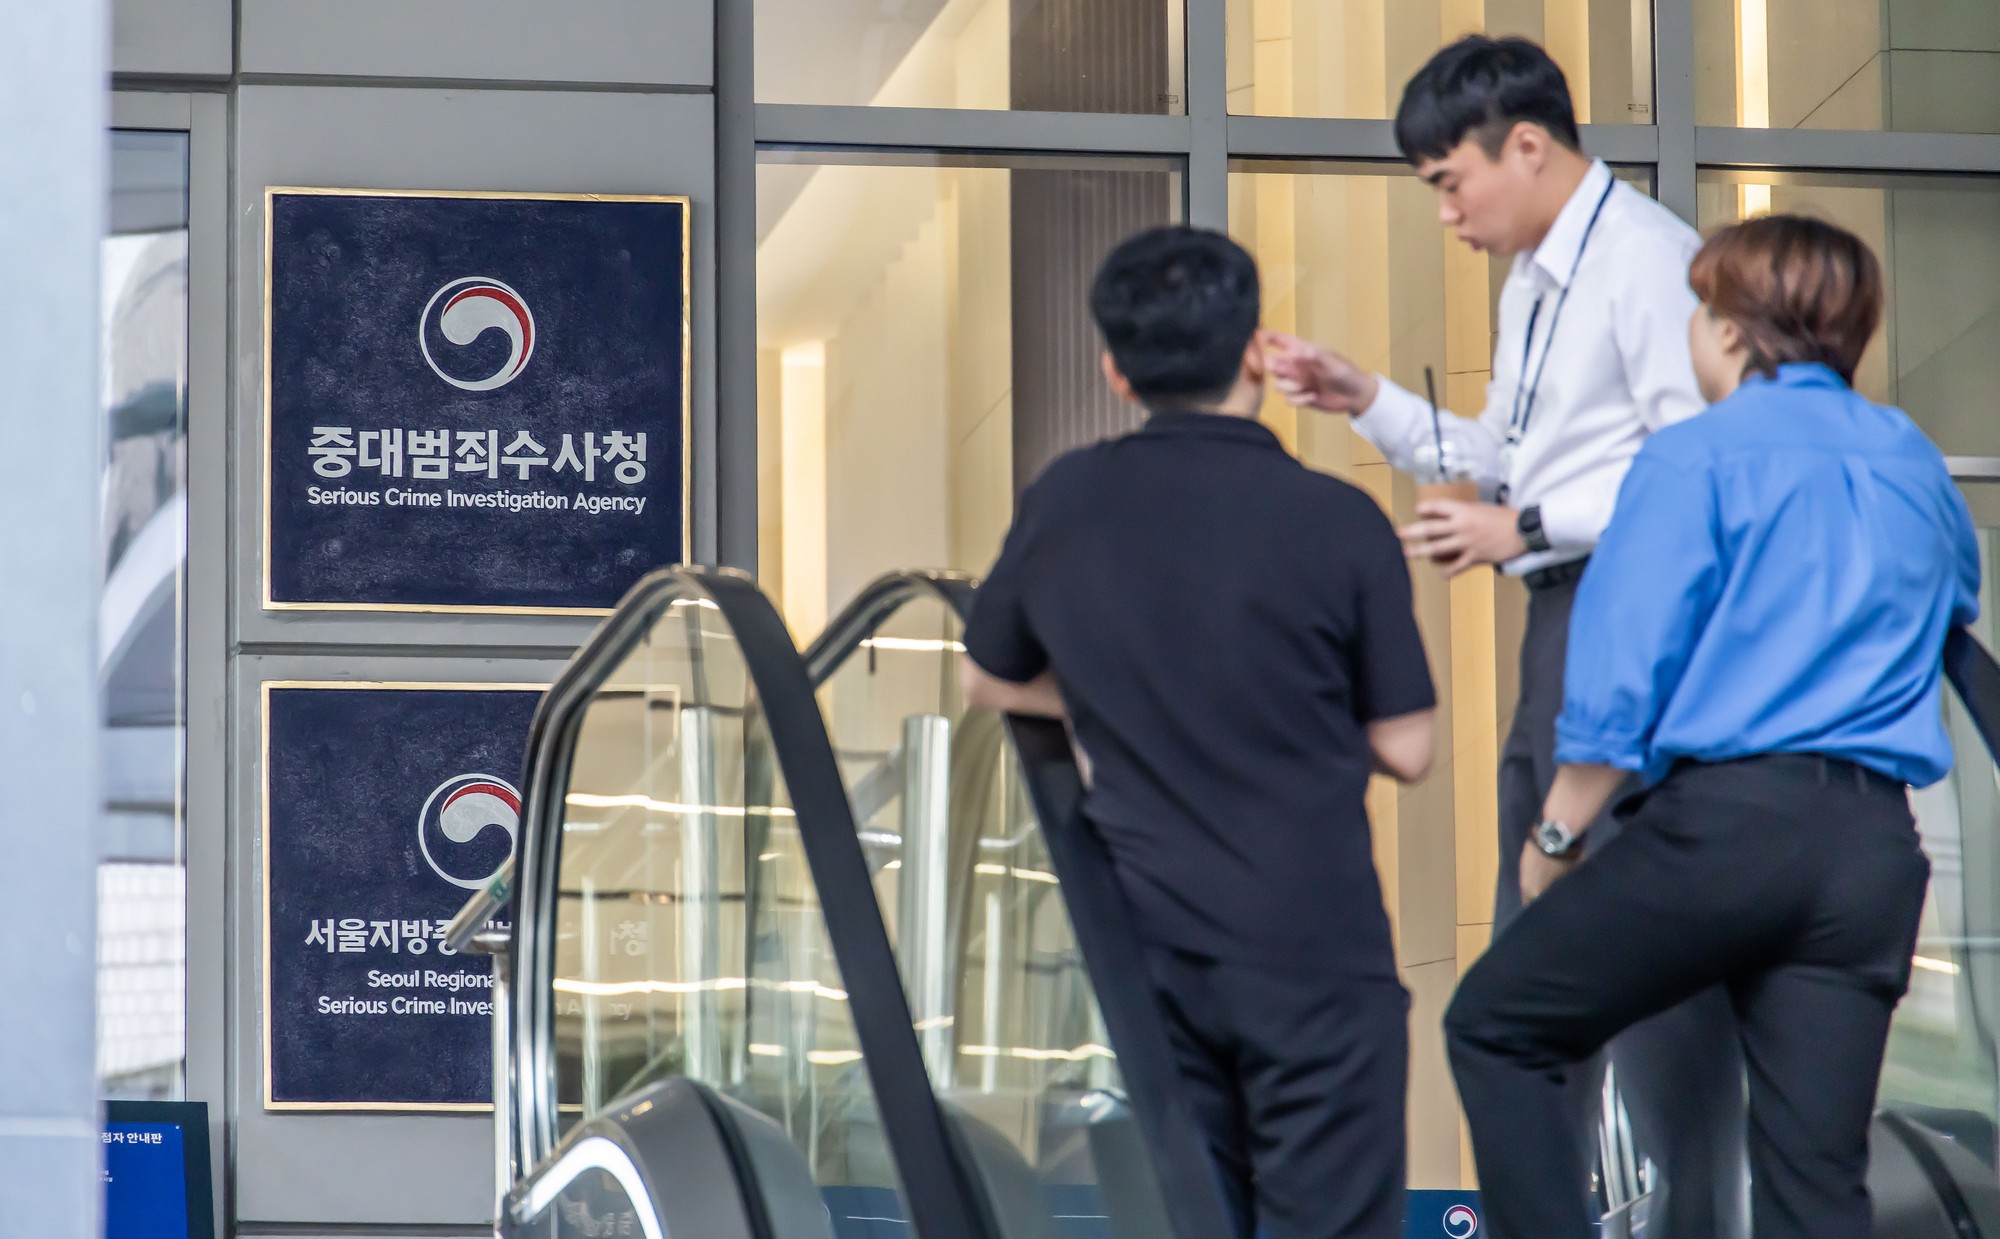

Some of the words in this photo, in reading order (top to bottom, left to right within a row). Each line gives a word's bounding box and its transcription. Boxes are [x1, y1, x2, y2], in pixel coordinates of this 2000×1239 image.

[307, 426, 647, 484] 중대범죄수사청
[307, 486, 379, 506] Serious
[384, 487, 442, 507] Crime
[446, 488, 569, 512] Investigation
[572, 492, 647, 515] Agency
[367, 969, 420, 988] Seoul
[424, 969, 494, 992] Regiona
[317, 995, 388, 1014] Serious
[391, 996, 446, 1014] Crime
[126, 1132, 163, 1144] 안내판
